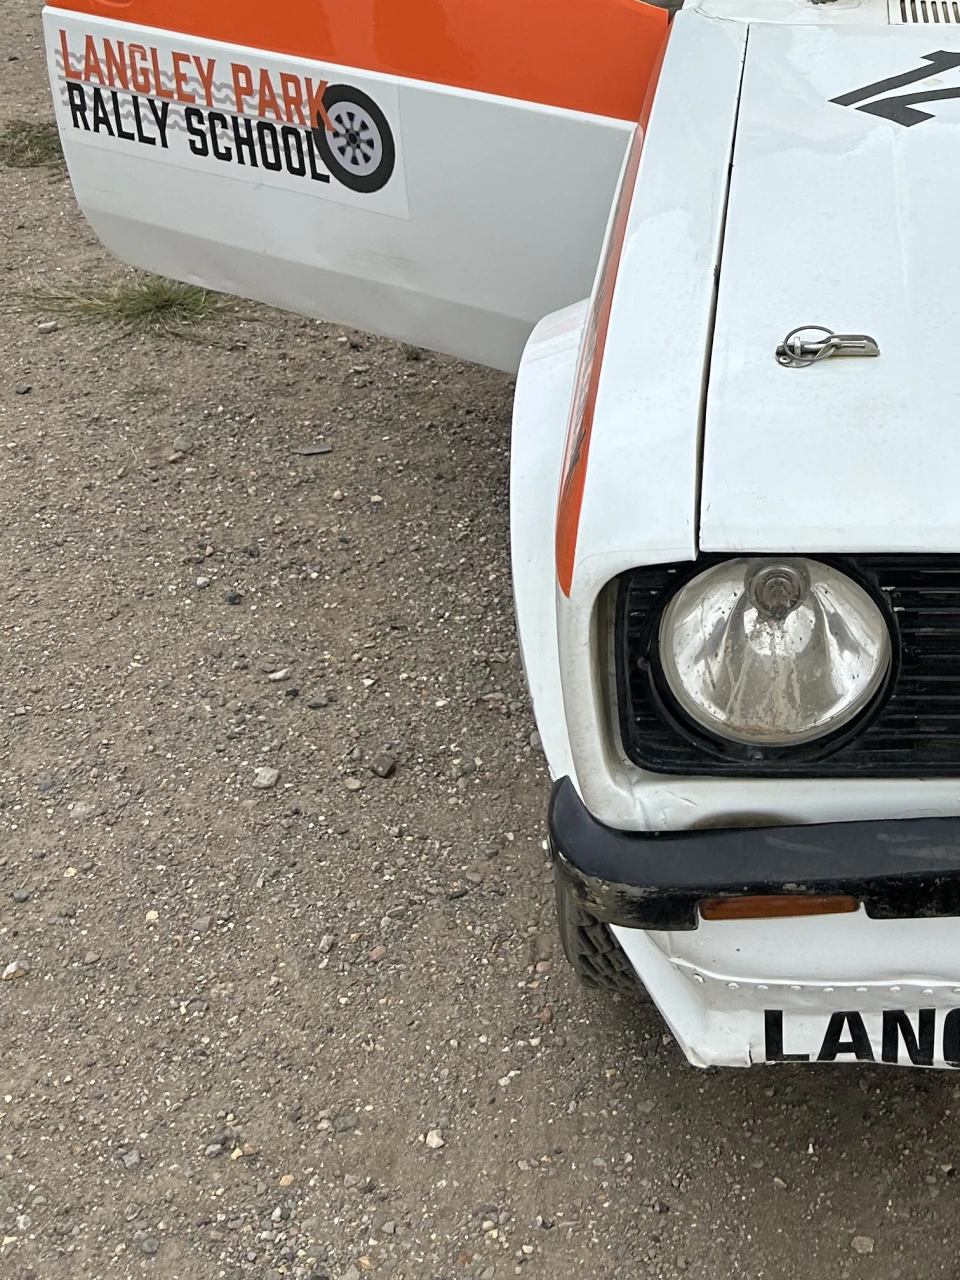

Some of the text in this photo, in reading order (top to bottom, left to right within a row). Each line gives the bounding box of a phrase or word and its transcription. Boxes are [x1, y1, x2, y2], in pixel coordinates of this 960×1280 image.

[59, 29, 334, 132] LANGLEY PARK
[66, 81, 330, 183] RALLY SCHOOL
